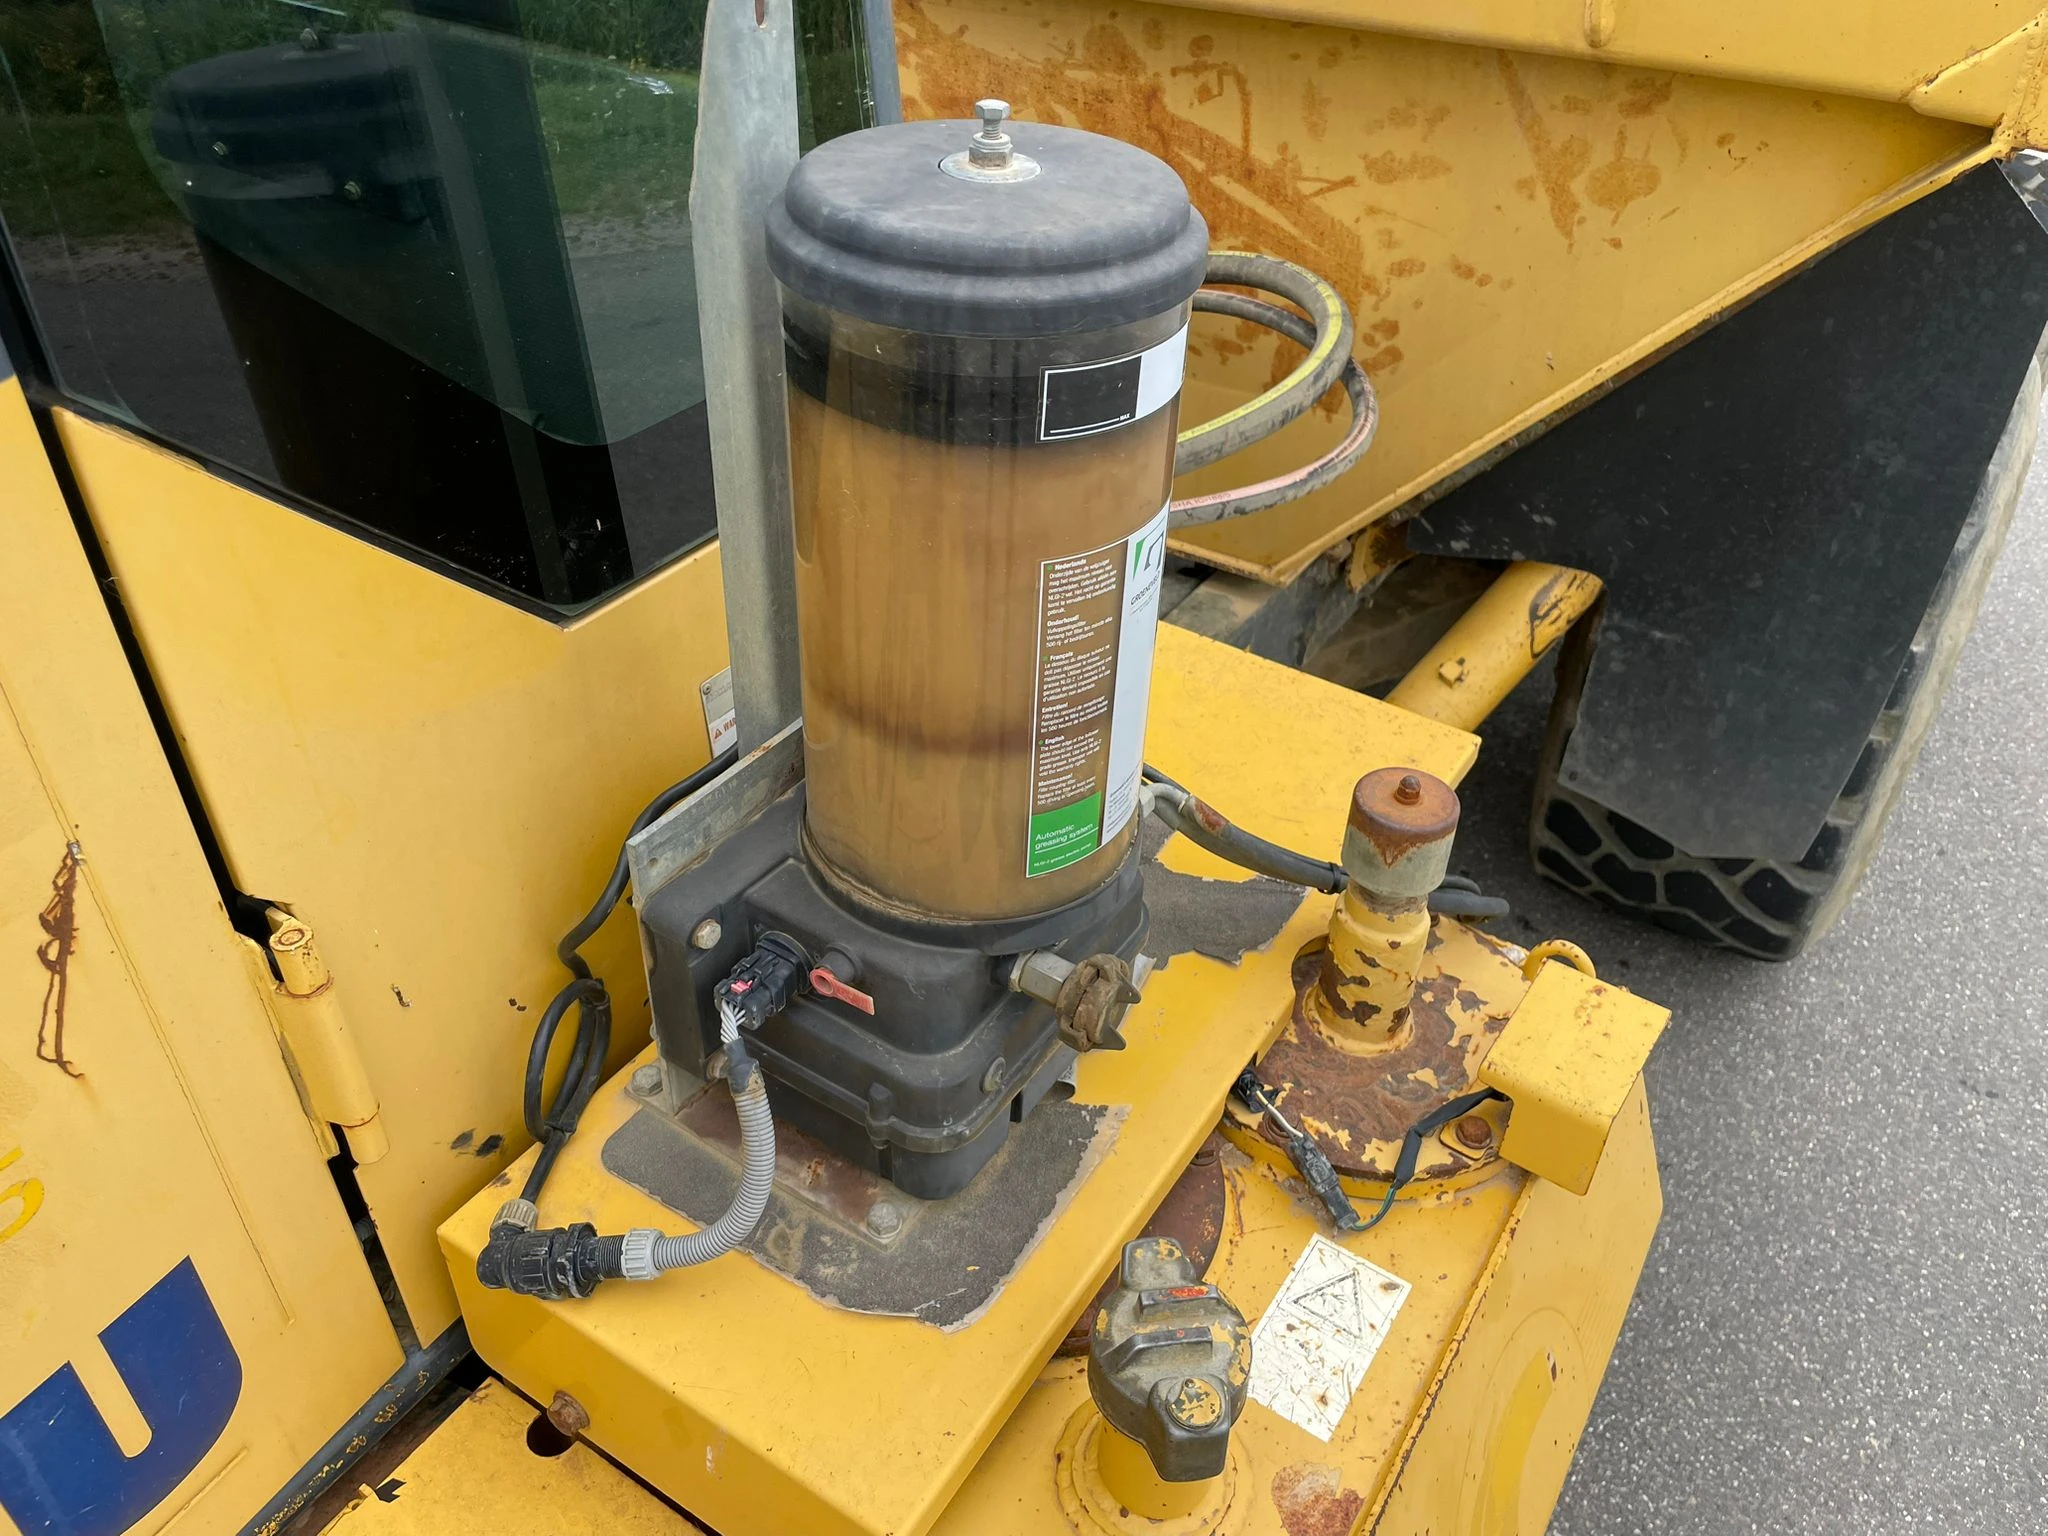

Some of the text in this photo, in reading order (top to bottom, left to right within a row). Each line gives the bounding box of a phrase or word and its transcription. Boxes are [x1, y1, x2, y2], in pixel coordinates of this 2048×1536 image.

[1045, 735, 1064, 744] English
[1035, 824, 1093, 850] greasing system
[1036, 825, 1074, 841] Automatic
